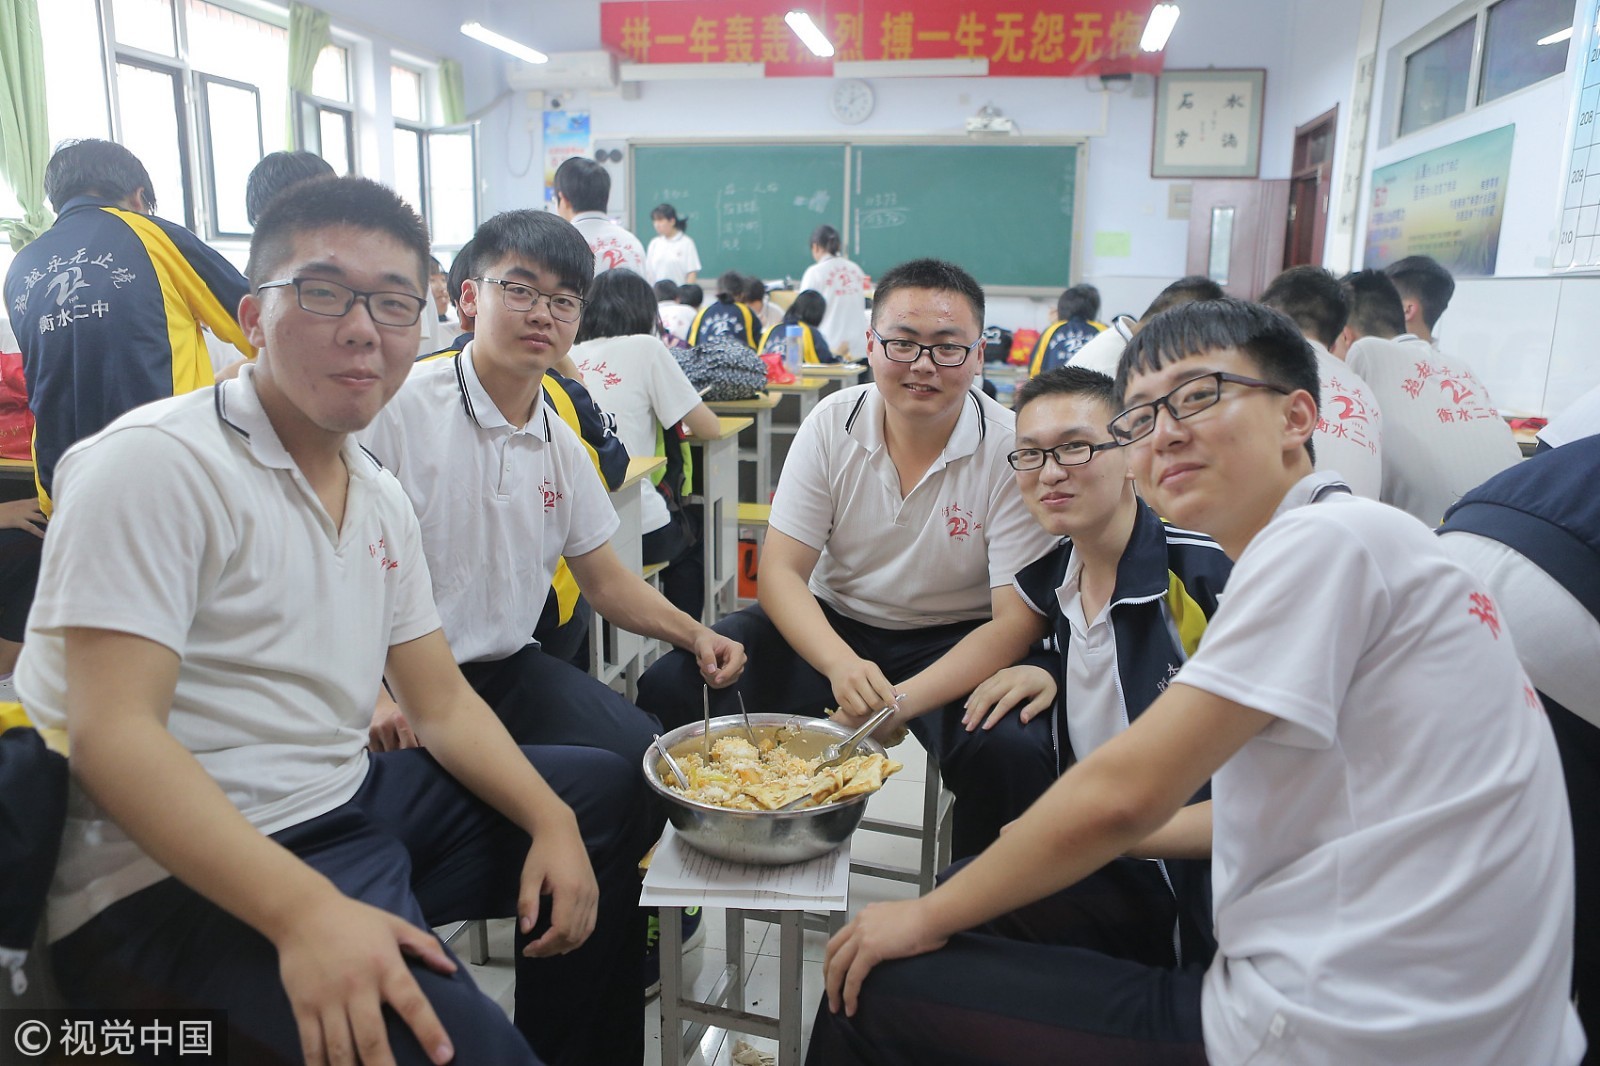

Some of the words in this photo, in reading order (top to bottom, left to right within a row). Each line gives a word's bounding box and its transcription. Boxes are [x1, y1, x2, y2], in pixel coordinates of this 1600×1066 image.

[880, 10, 1144, 63] 搏一生无怨无悔
[1579, 110, 1593, 126] 208
[1571, 168, 1584, 184] 209
[1561, 230, 1573, 244] 210
[39, 299, 110, 335] 衡水二中
